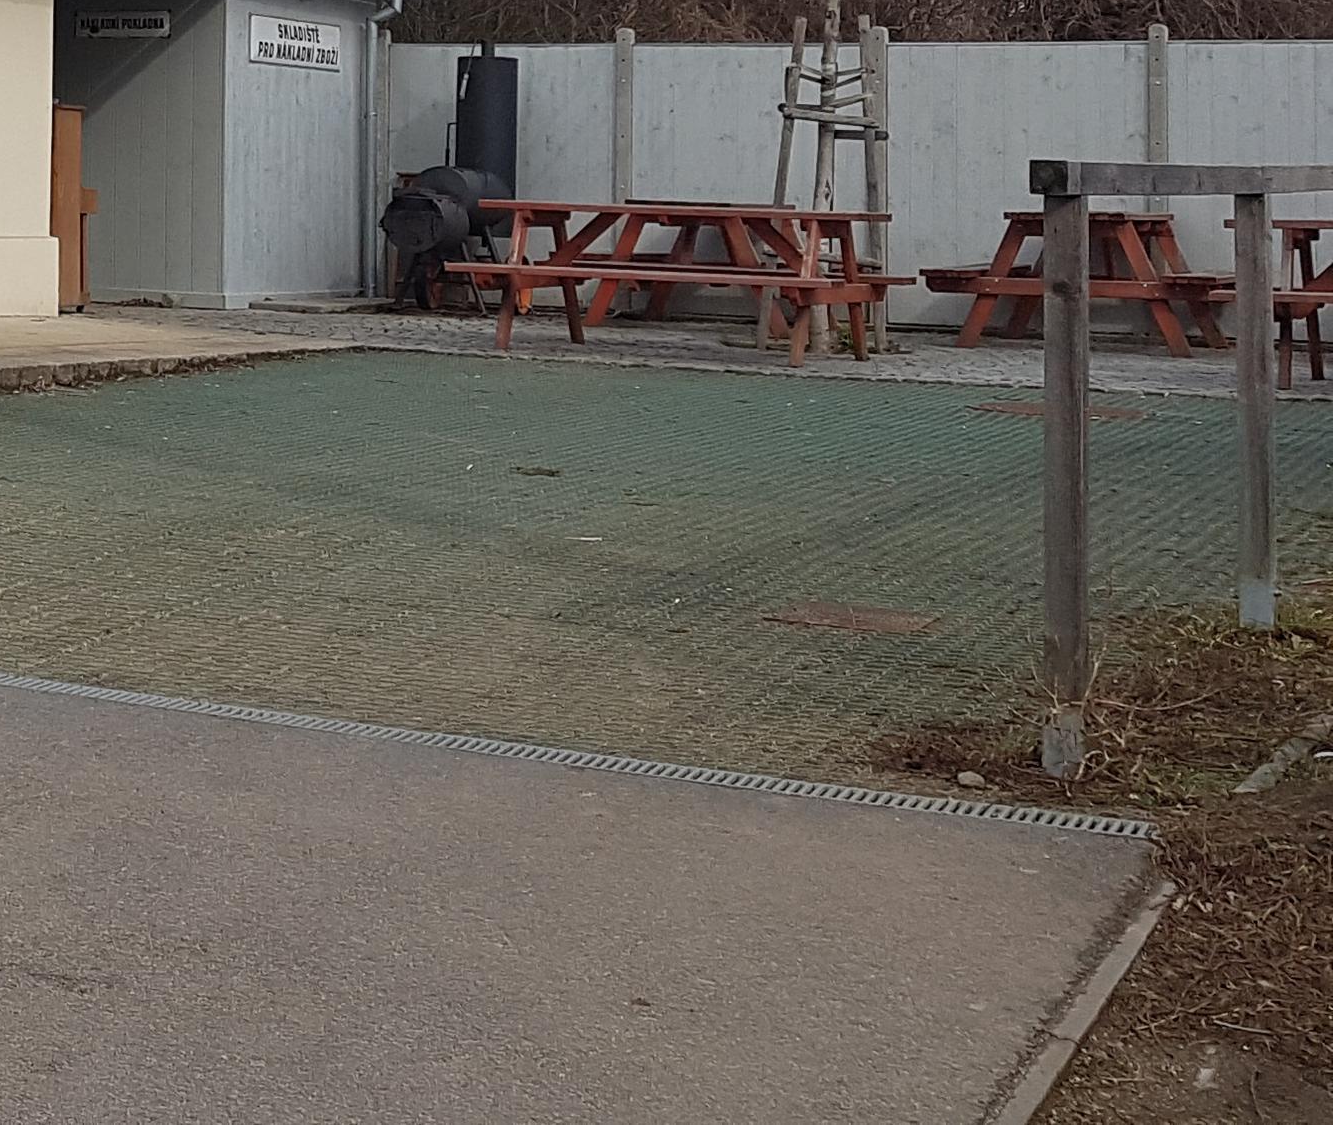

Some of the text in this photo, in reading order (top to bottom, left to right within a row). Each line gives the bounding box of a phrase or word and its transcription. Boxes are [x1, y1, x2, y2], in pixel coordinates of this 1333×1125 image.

[278, 23, 320, 43] SKLADIŠTĚ
[258, 41, 339, 65] PRO NÁKLADNÍ ZBOŽÍ
